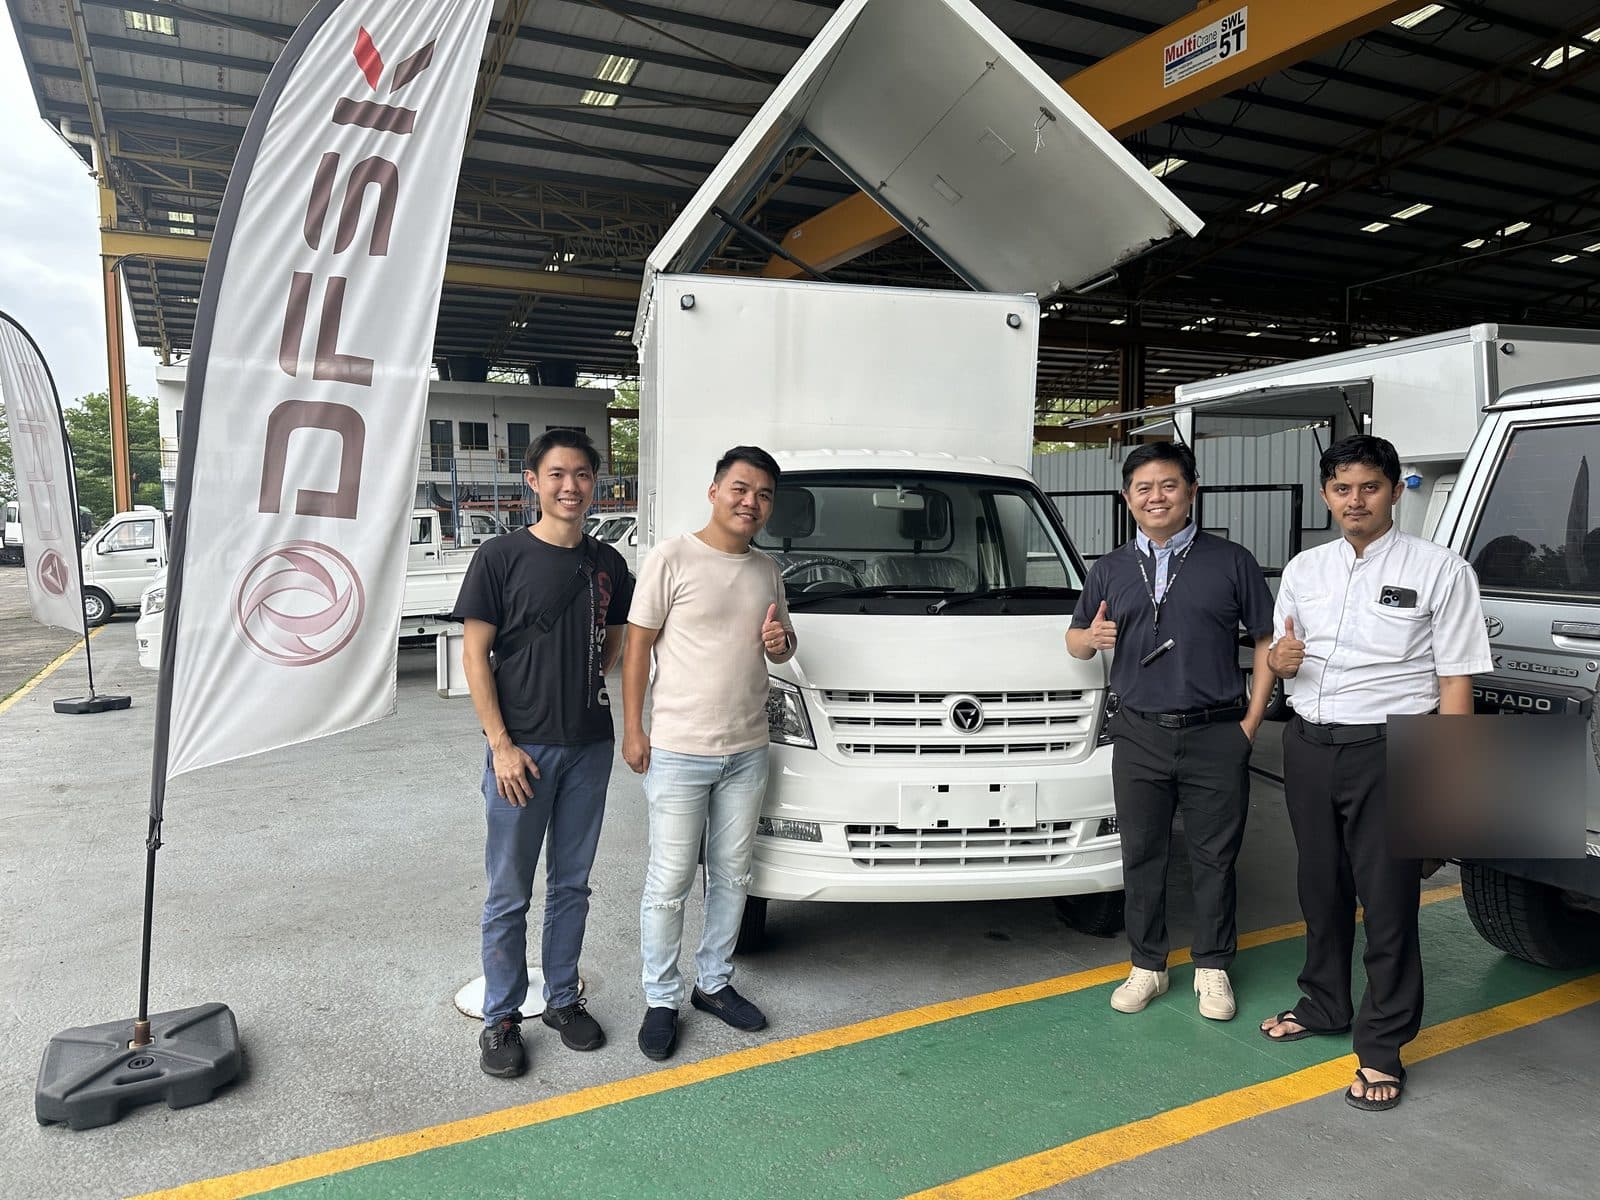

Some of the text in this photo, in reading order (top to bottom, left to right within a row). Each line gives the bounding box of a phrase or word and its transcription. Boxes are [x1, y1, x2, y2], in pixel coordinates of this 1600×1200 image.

[1221, 12, 1244, 32] SWL
[1219, 24, 1245, 59] 5T
[259, 26, 437, 520] DFSK
[1507, 661, 1530, 671] 3.0
[1532, 664, 1579, 677] turbo
[1472, 689, 1551, 711] PRADO
